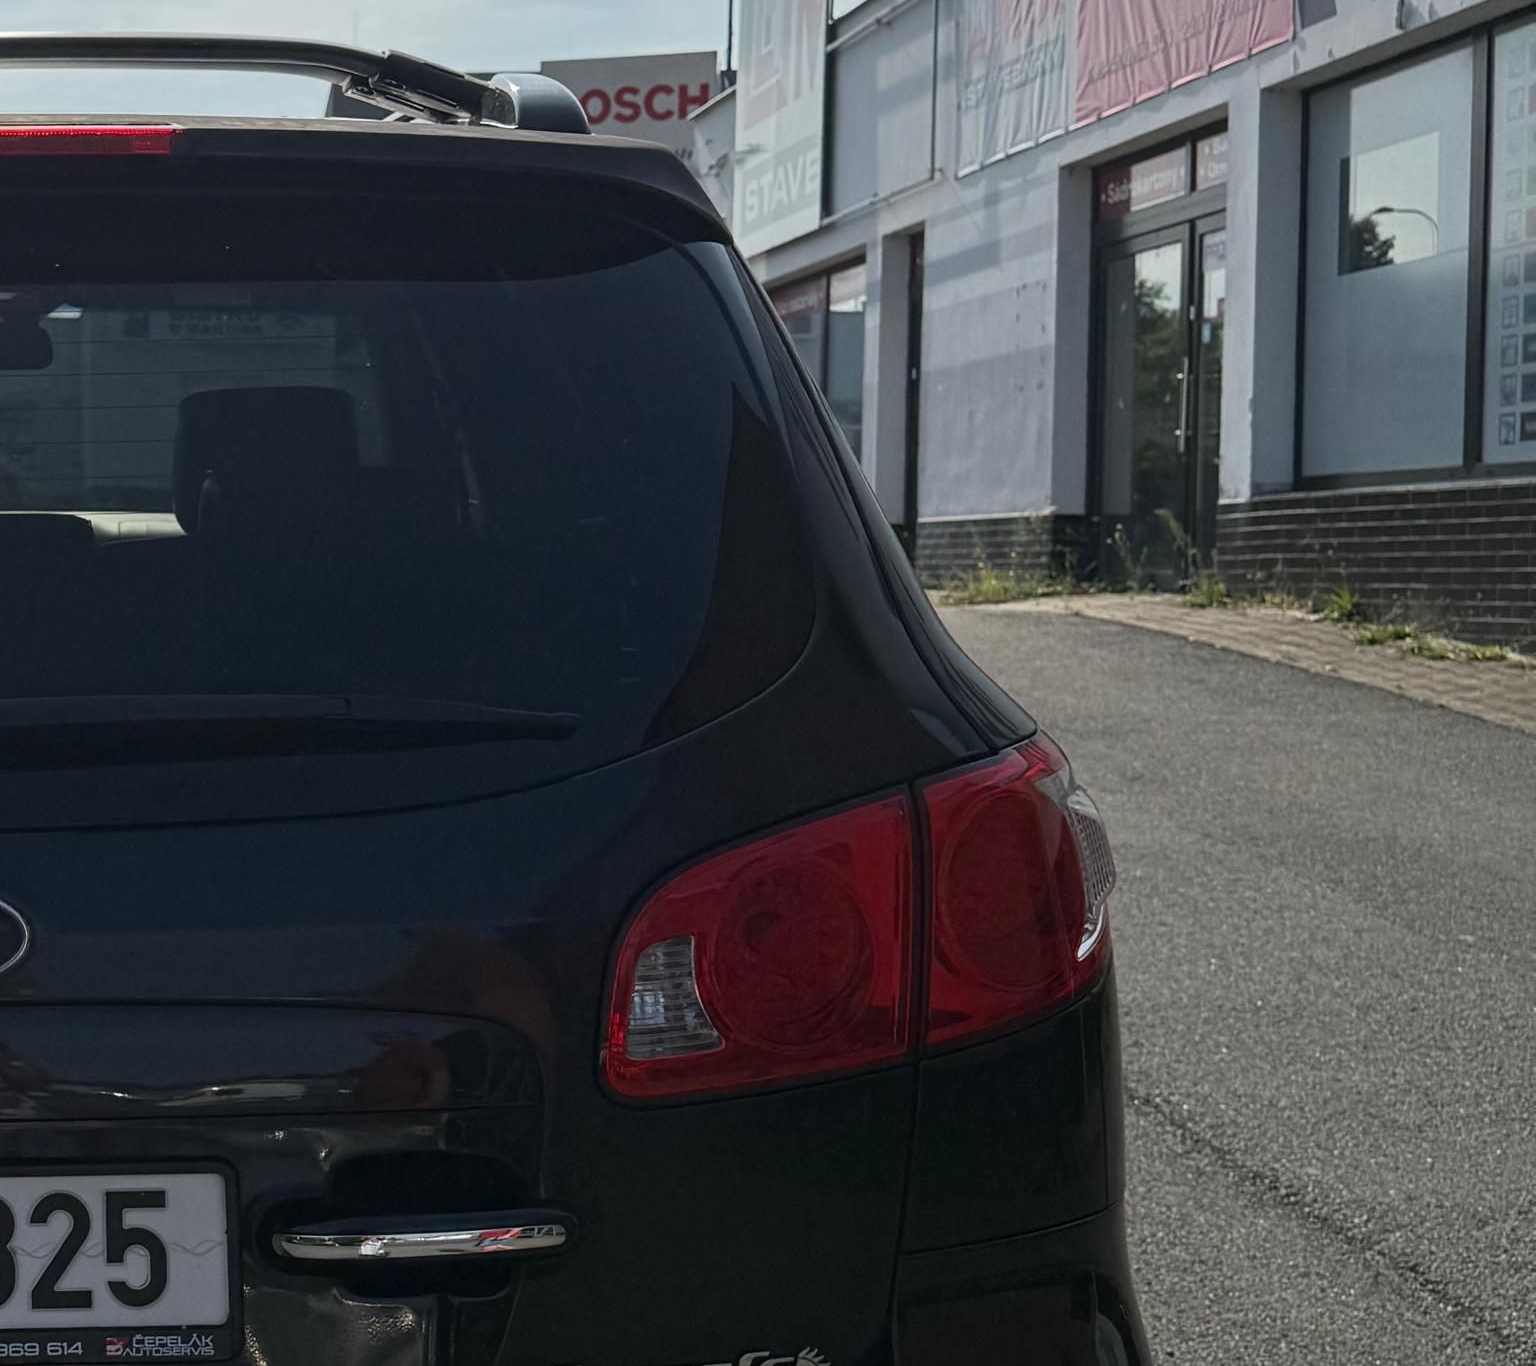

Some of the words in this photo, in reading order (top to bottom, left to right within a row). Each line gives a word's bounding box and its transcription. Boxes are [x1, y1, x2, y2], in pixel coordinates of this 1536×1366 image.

[580, 82, 711, 126] OSCH
[47, 1341, 83, 1355] 614
[122, 1346, 215, 1356] AUTOSERVIS
